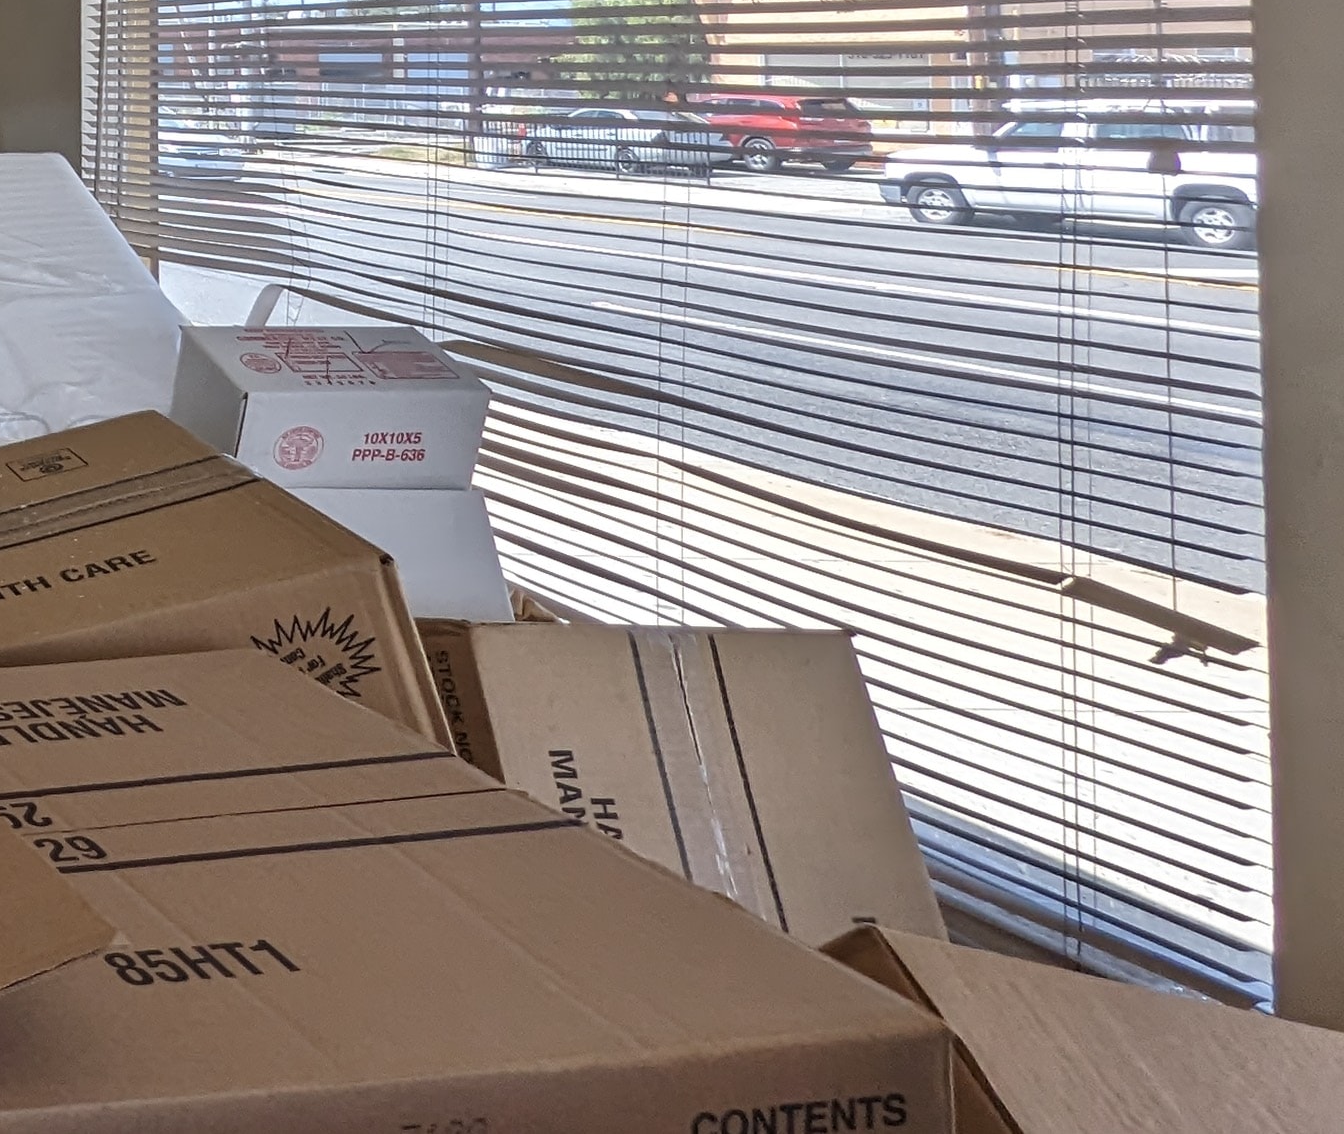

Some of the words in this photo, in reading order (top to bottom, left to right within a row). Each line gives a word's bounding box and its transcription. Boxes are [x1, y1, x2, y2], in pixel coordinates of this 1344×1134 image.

[351, 448, 426, 462] PPP-B-636
[363, 432, 423, 445] 10X10X5
[60, 549, 158, 583] CARE
[432, 649, 466, 725] STOCK
[32, 834, 109, 864] 29
[103, 940, 301, 987] 85HT1
[691, 1093, 908, 1134] CONTENTS
